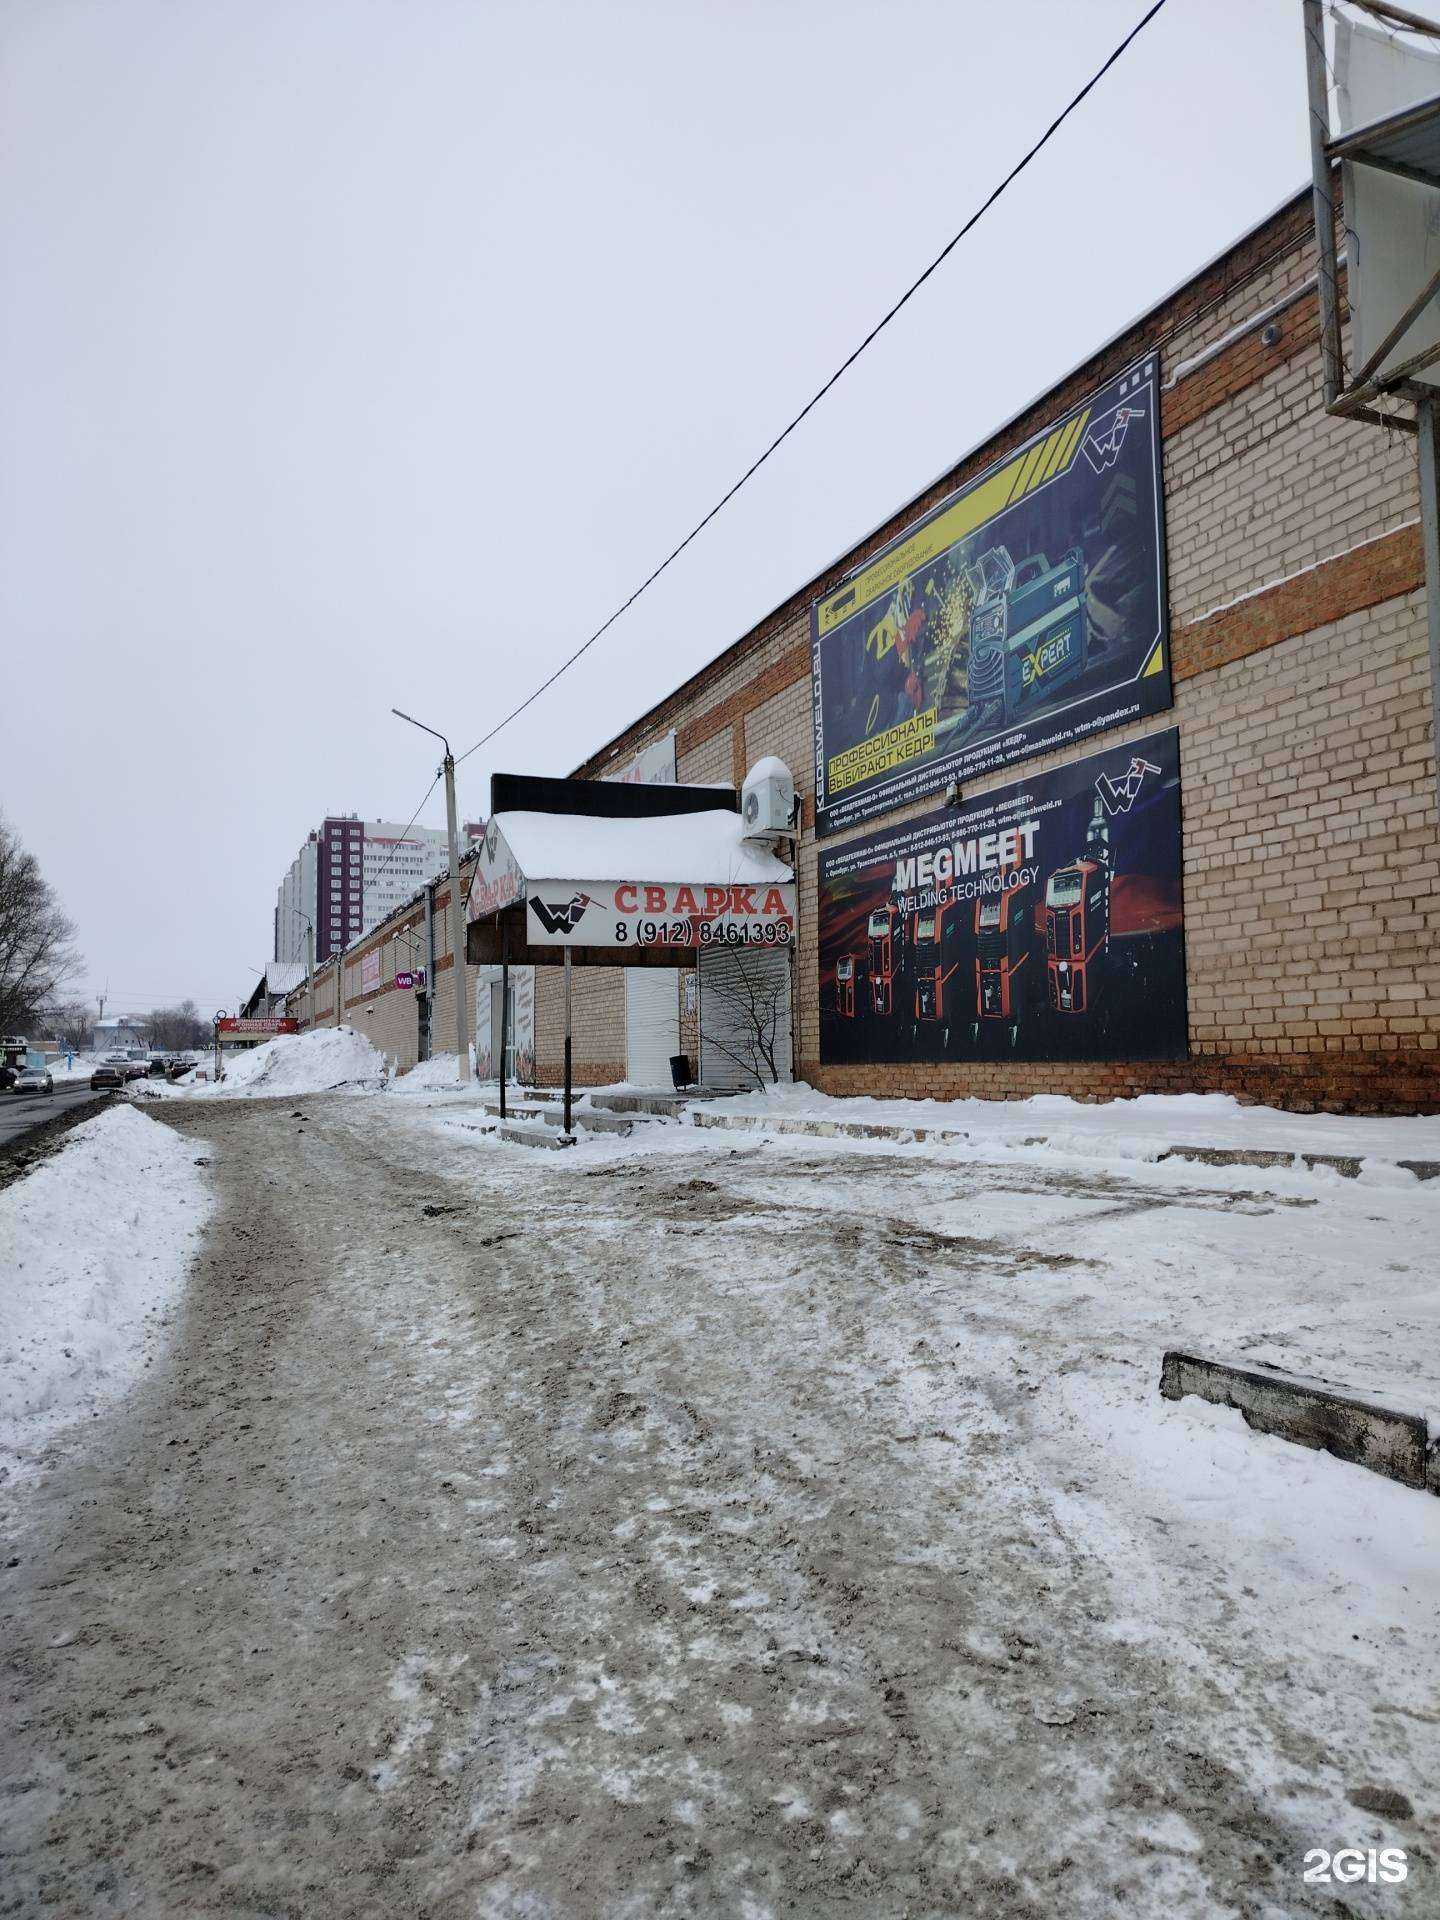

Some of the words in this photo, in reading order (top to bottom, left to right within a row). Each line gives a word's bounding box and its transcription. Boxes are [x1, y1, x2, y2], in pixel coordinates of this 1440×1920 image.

[812, 641, 826, 813] KEDRWELD.RU
[829, 708, 936, 774] ПРОФЕССИОНАЛЫ
[1074, 703, 1140, 734] wtm-o@yandex.ru
[829, 751, 894, 792] ВЫБИРАЮТ
[896, 734, 934, 762] КЕДР!
[829, 808, 839, 818] ООО
[878, 775, 917, 797] ОФИЦИАЛЬНЫЙ
[917, 757, 963, 783] ДИСТРИБЬЮТОР
[963, 741, 1001, 763] ПРОДУКЦИИ
[1002, 733, 1027, 748] «КЕДР»
[912, 819, 956, 841] ДИСТРИБЬЮТОР
[957, 807, 995, 825] ПРОДУКЦИИ
[995, 794, 1034, 814] «MEGMEET»
[896, 821, 1040, 892] MEGMEET
[614, 885, 788, 916] СВАРКА
[897, 888, 947, 914] WELDING
[951, 865, 1040, 902] TECHNOLOGY
[615, 921, 628, 943] 8
[636, 919, 692, 946] (912)
[699, 922, 790, 945] 8461393
[397, 977, 412, 985] WB
